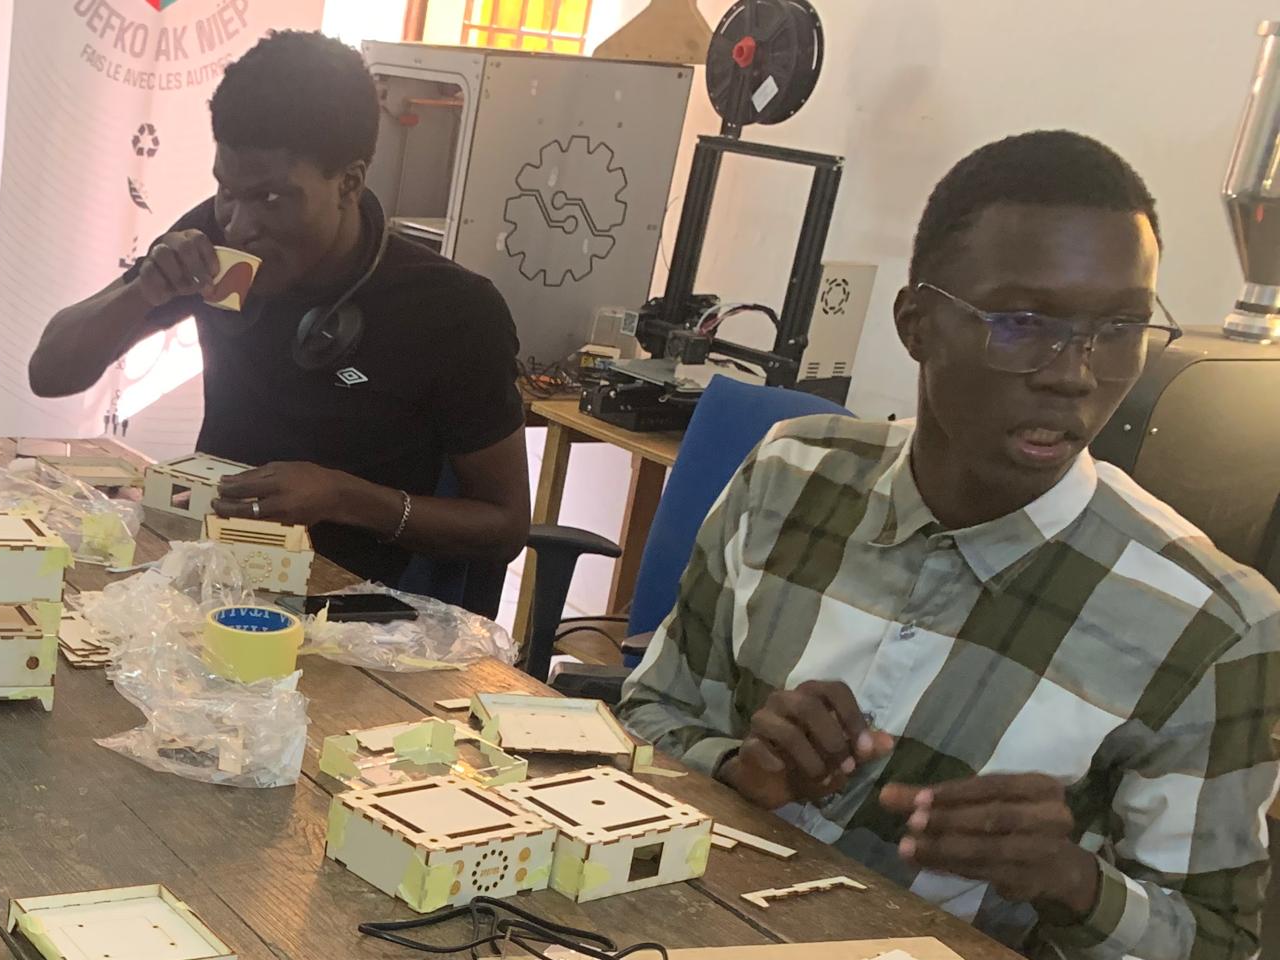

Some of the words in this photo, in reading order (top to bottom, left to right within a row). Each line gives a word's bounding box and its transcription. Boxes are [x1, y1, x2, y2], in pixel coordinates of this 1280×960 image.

[154, 27, 189, 62] AK
[106, 60, 122, 81] LE
[122, 68, 156, 90] AVEC
[158, 72, 182, 91] LES
